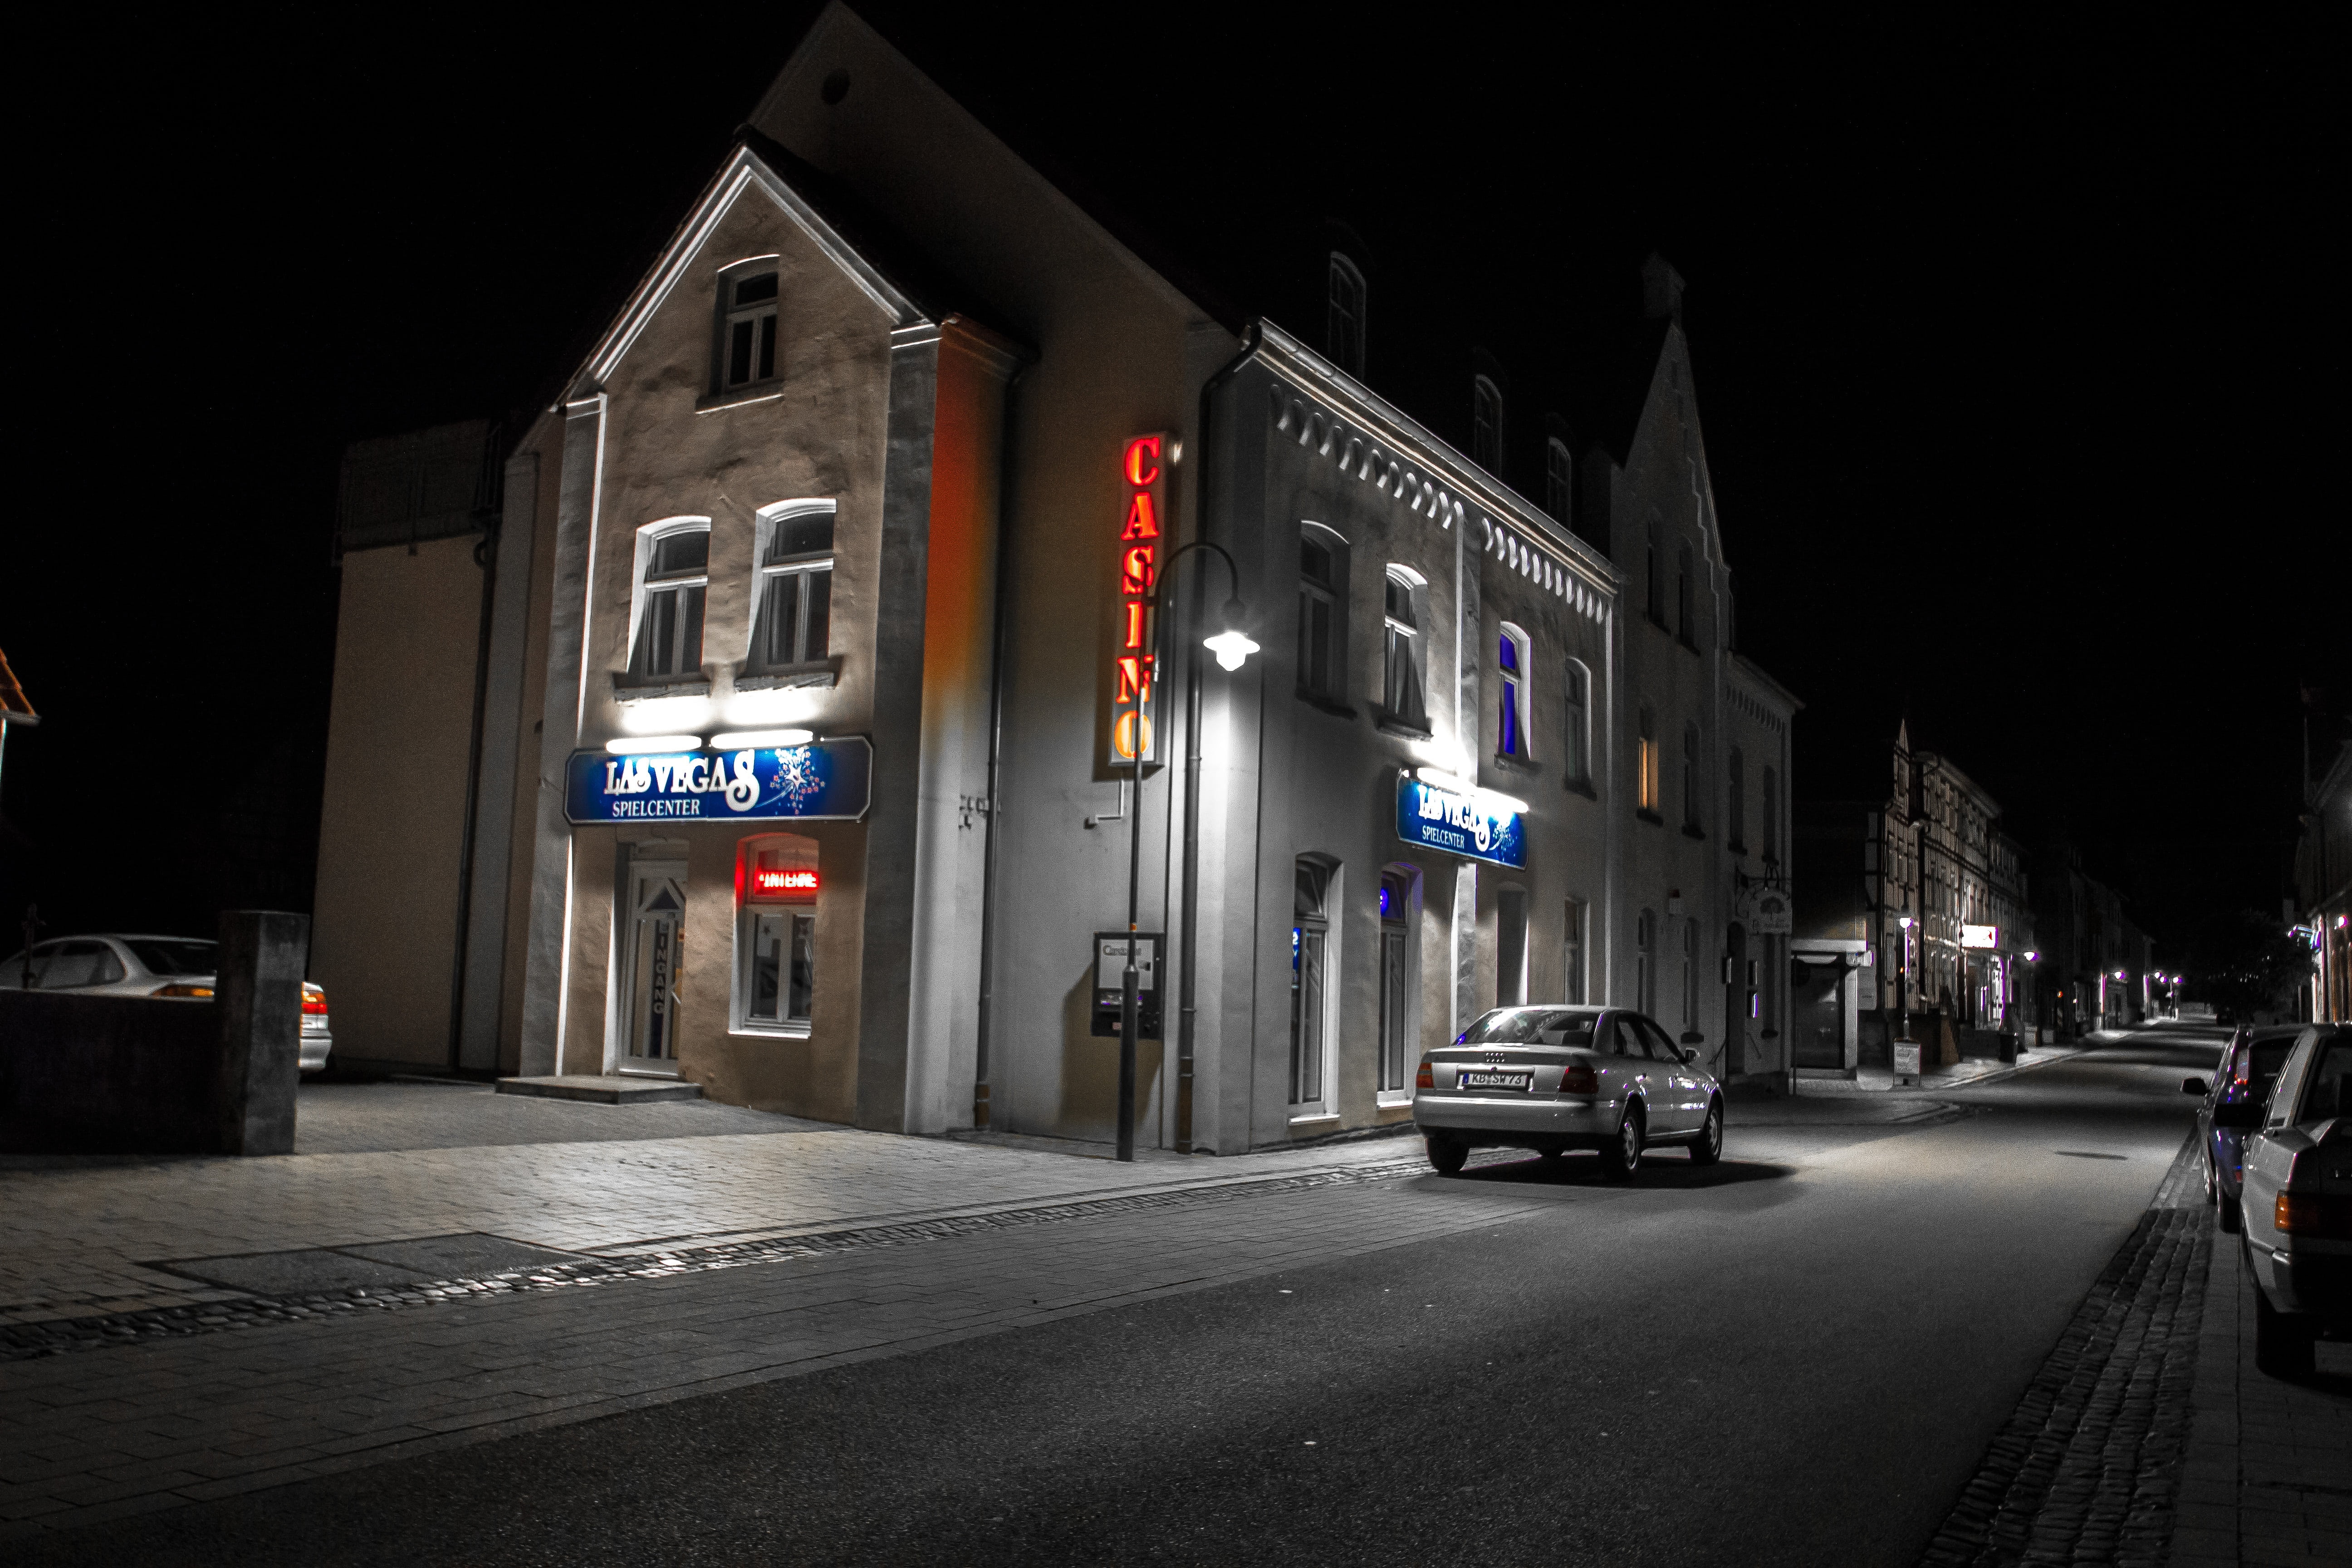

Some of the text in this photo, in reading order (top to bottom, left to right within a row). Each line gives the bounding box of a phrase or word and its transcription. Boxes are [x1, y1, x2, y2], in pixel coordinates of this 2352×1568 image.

[1114, 437, 1160, 759] CASINO
[612, 799, 700, 817] SPIELCENTER
[1422, 825, 1465, 849] SPIELCENTER
